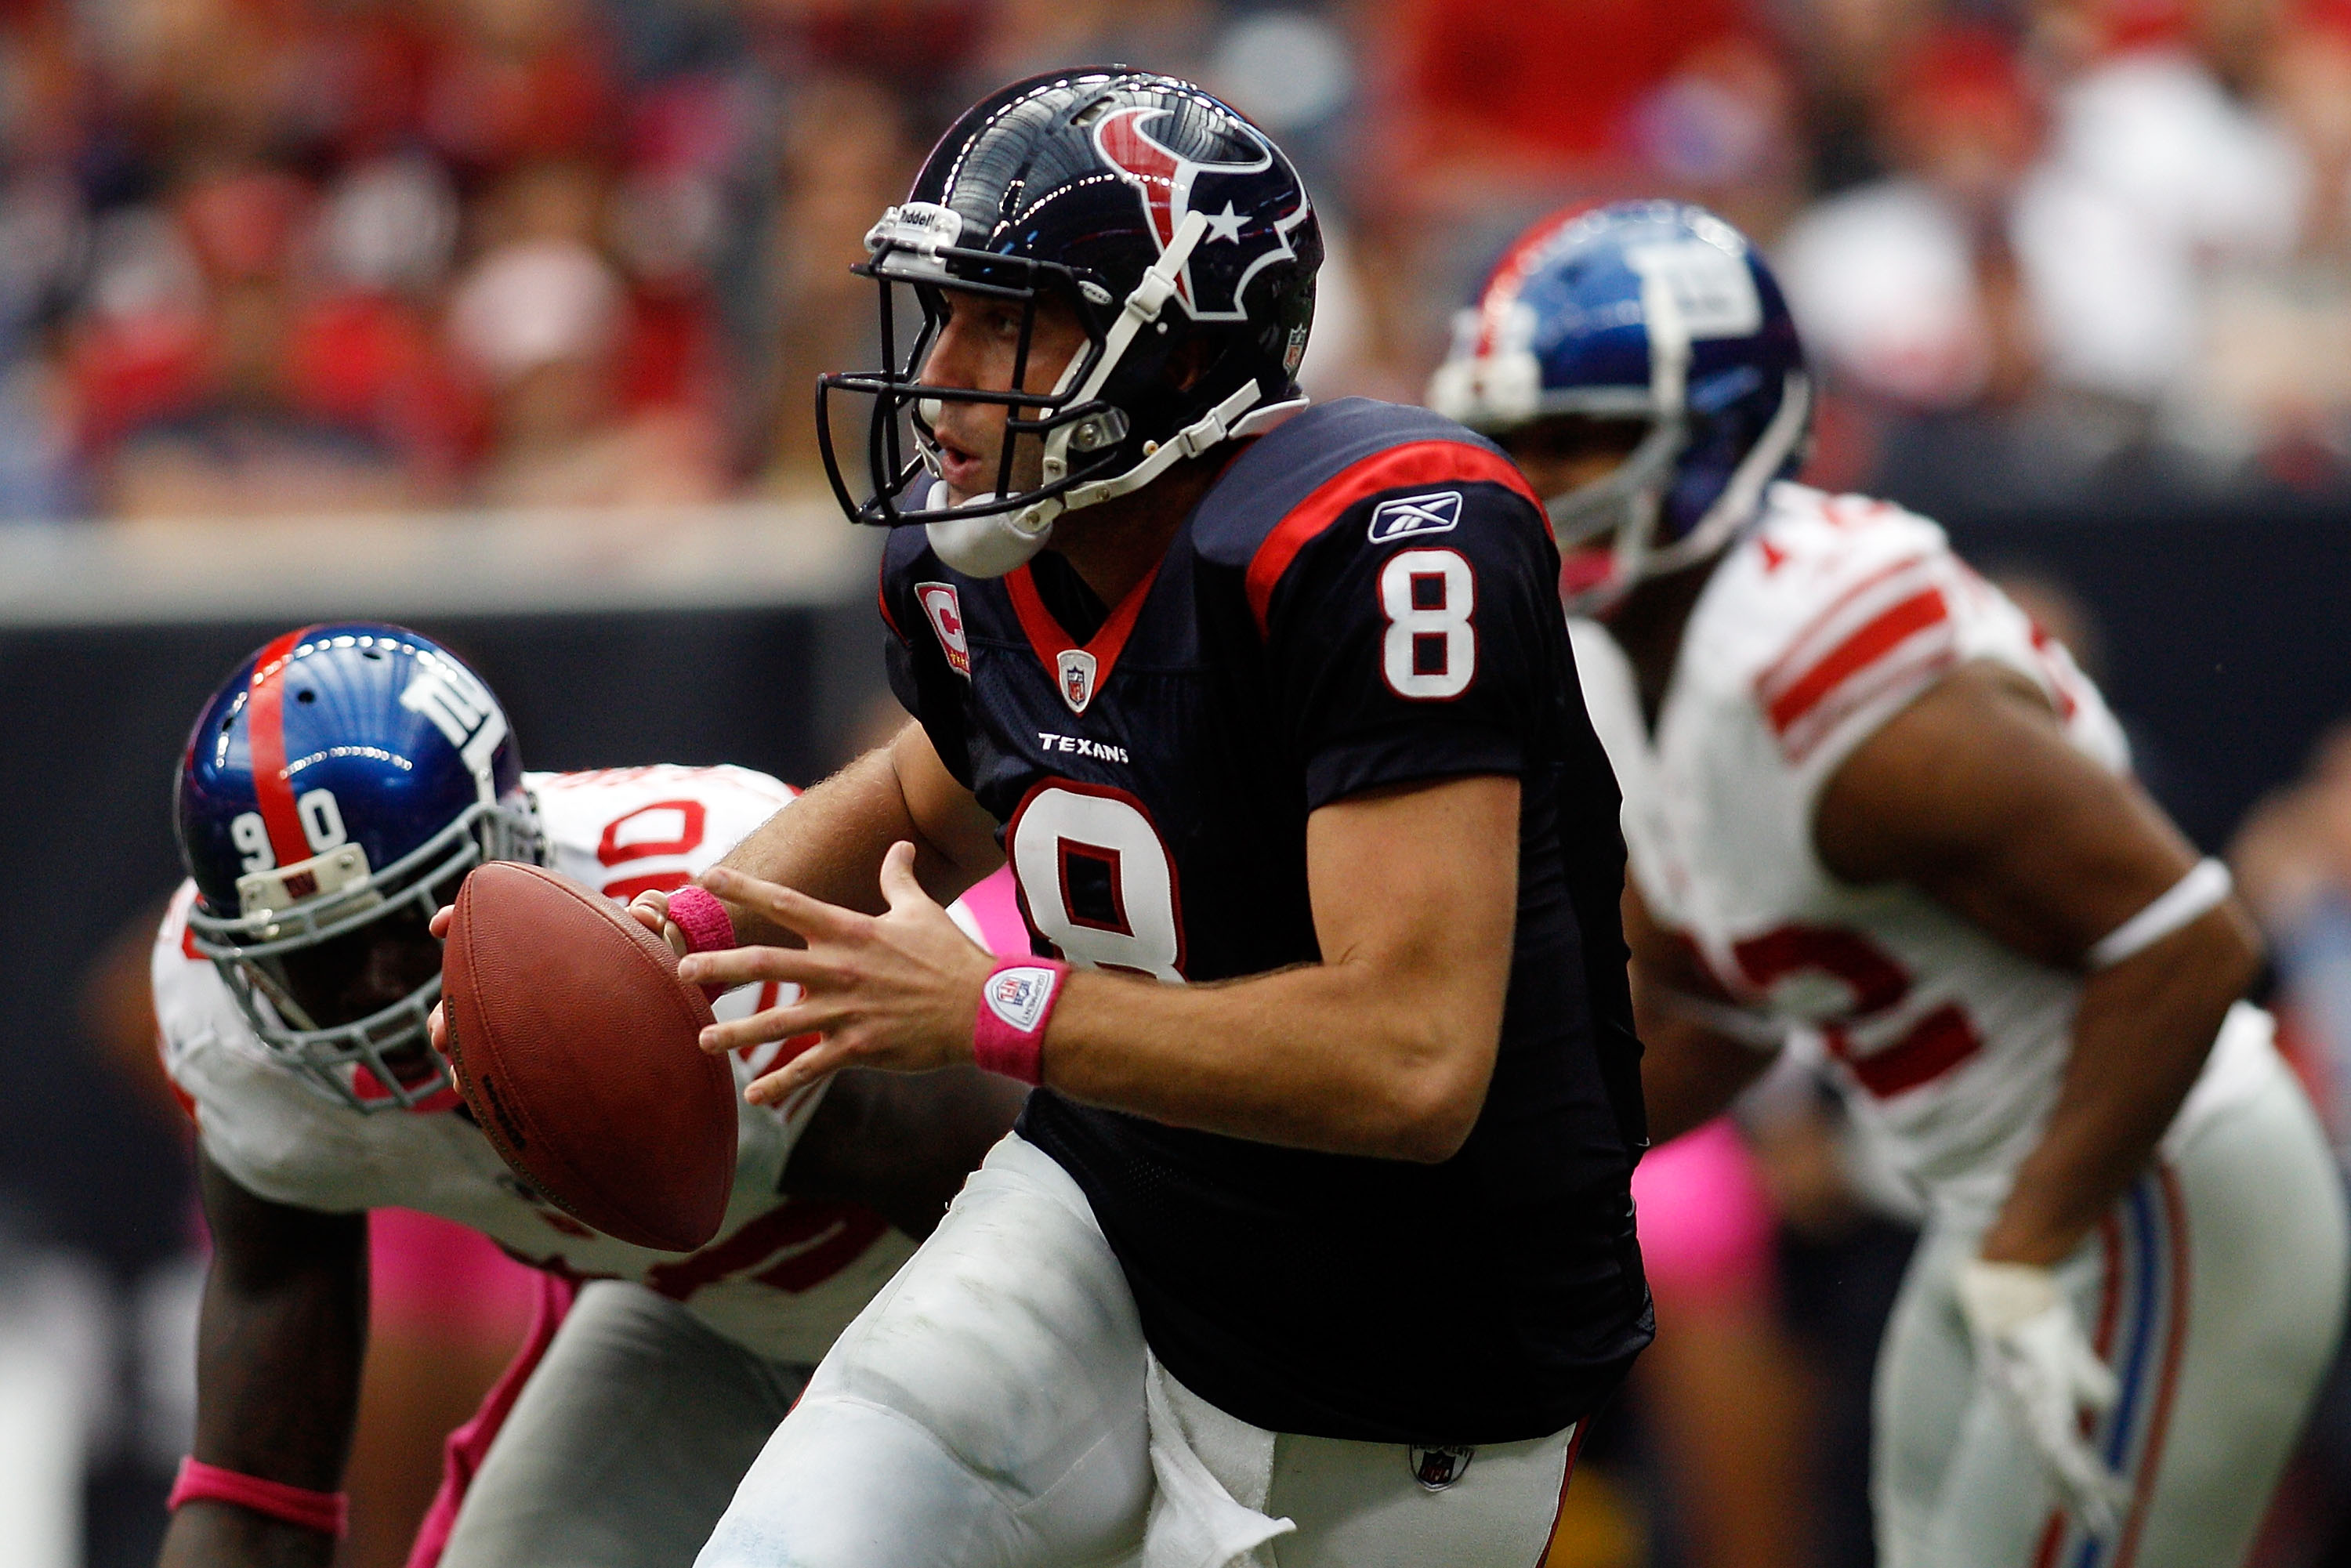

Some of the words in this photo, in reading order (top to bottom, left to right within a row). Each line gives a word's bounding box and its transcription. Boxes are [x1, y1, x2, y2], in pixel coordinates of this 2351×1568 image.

[926, 590, 965, 654] C
[1376, 547, 1480, 702] 8
[1038, 733, 1129, 763] TEXANS
